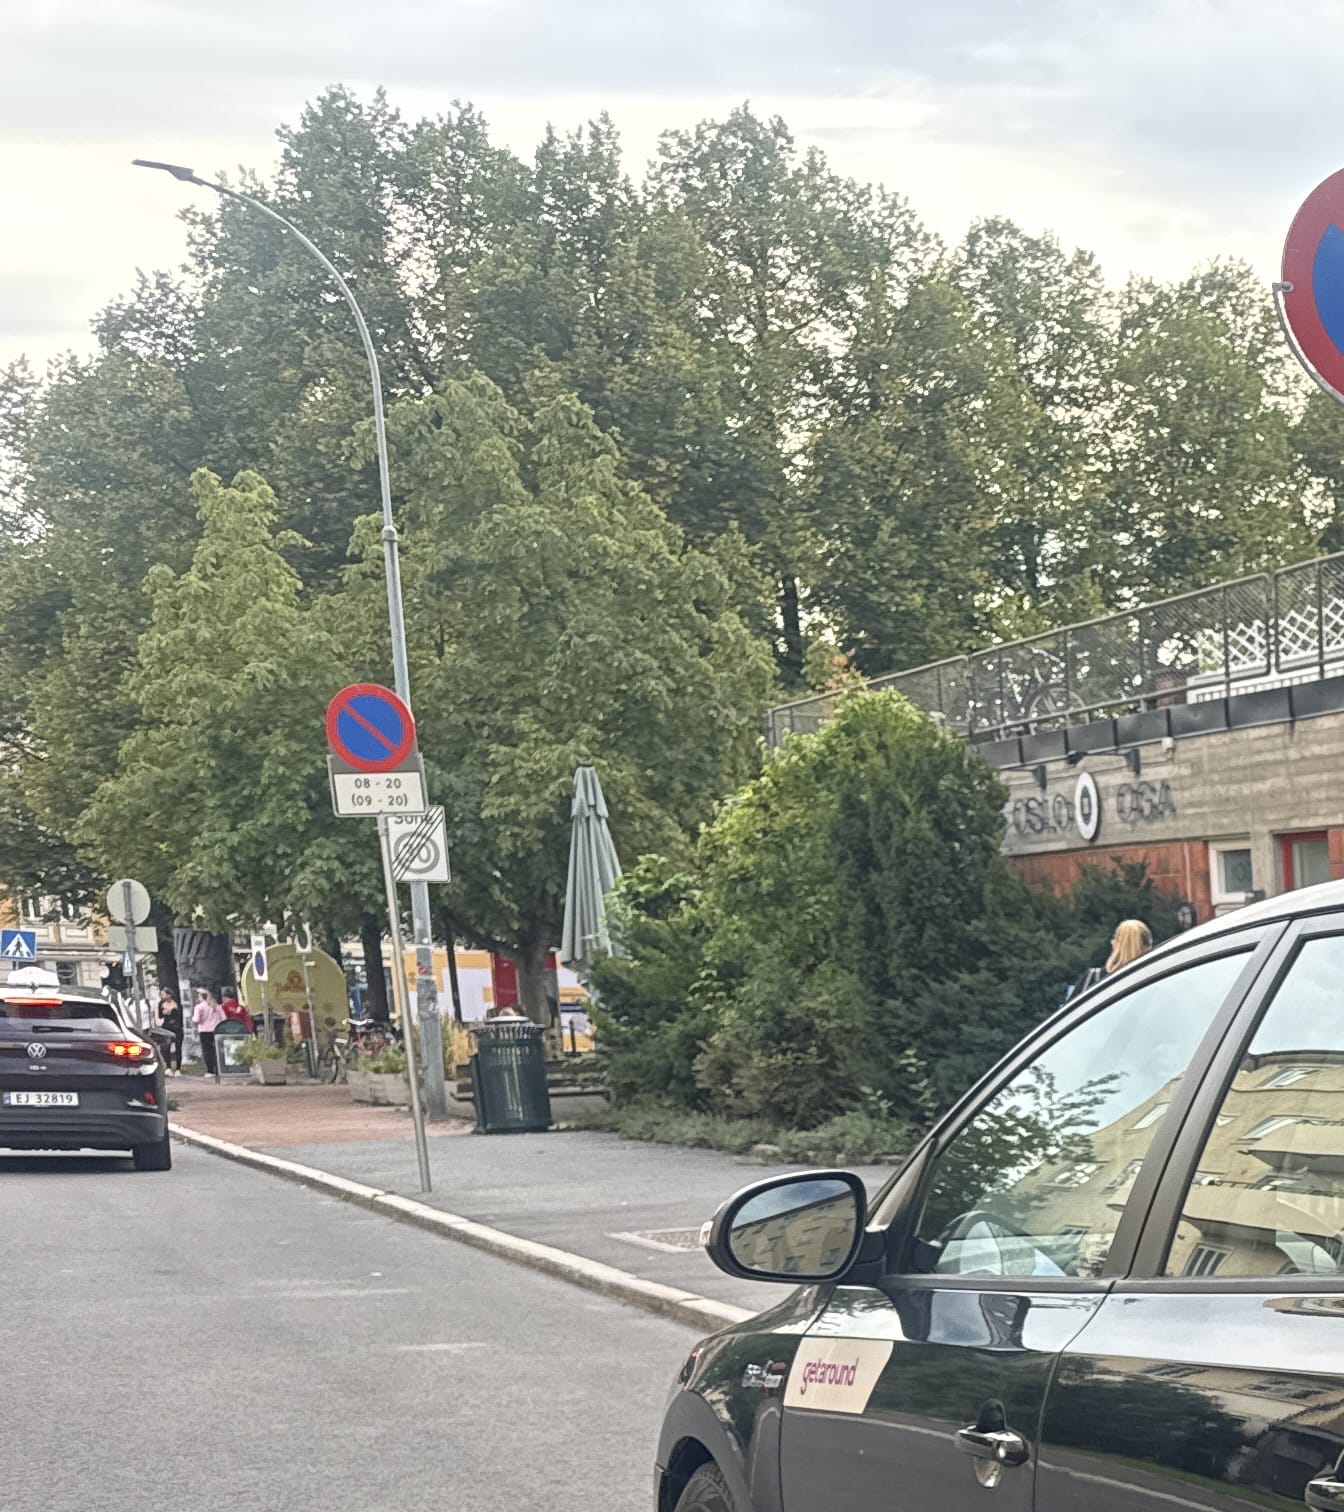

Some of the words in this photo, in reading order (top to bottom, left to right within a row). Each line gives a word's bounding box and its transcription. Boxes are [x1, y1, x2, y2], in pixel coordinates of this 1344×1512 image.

[354, 778, 371, 789] 08
[385, 778, 402, 789] 20
[351, 793, 372, 807] (09
[387, 793, 408, 807] 20)
[15, 1093, 29, 1104] EJ
[36, 1093, 73, 1104] 32819
[800, 1357, 860, 1395] getaround
